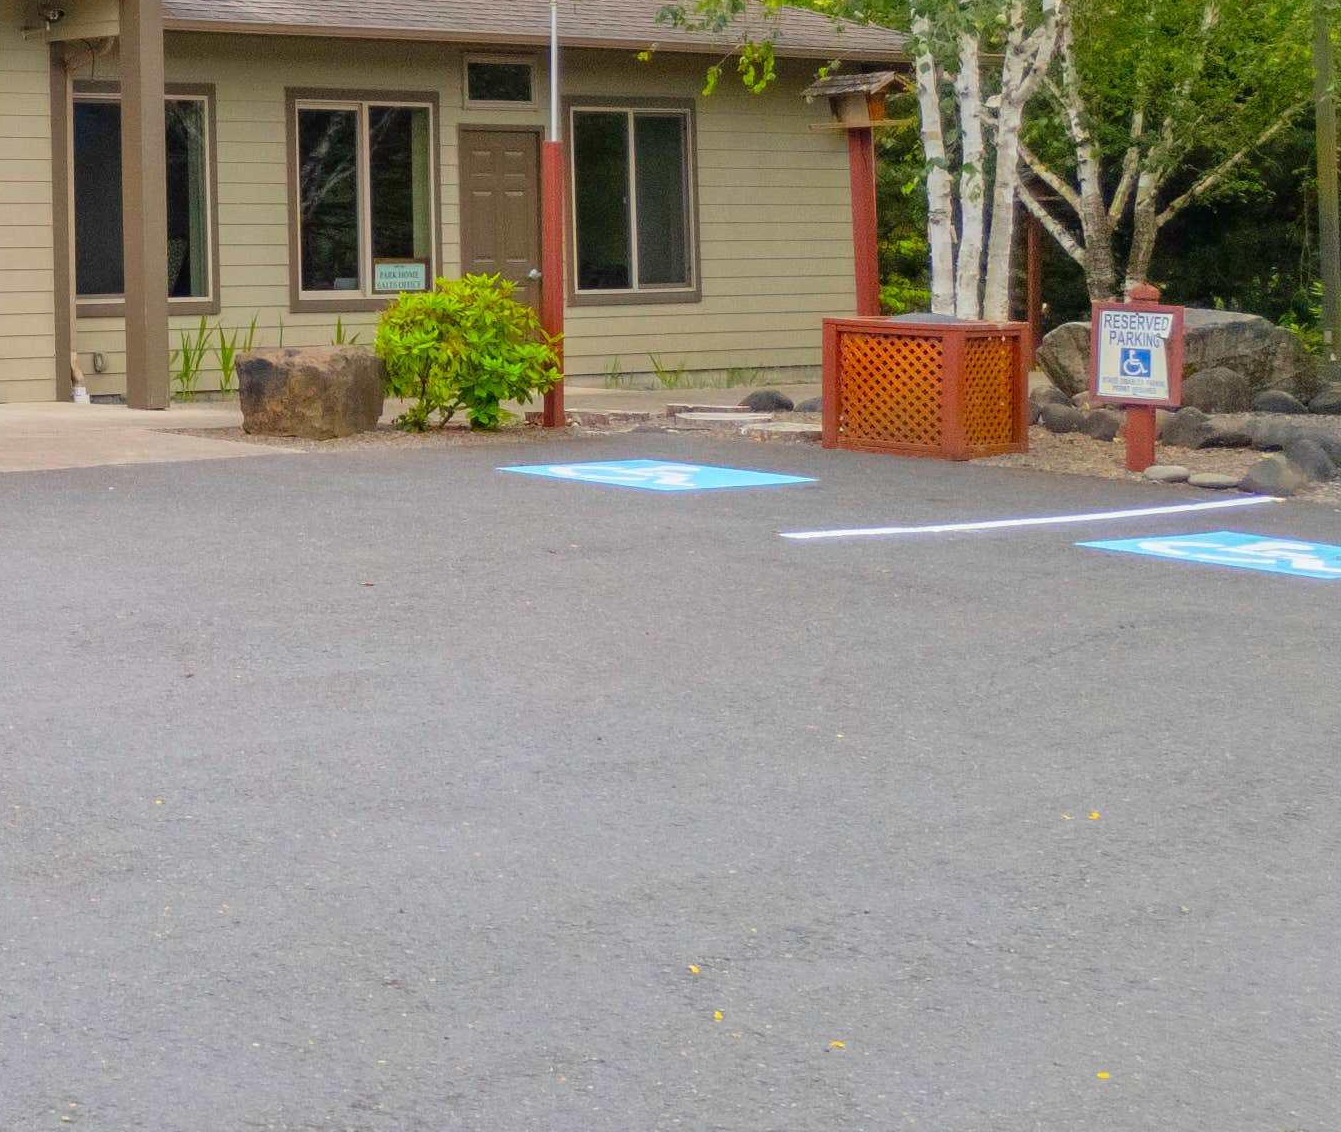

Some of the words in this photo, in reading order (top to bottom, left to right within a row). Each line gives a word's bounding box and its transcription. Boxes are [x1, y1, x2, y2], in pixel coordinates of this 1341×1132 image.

[380, 271, 397, 279] PARK
[399, 271, 420, 279] HOME
[1103, 313, 1170, 331] RESERVED
[1109, 330, 1161, 349] PARKING
